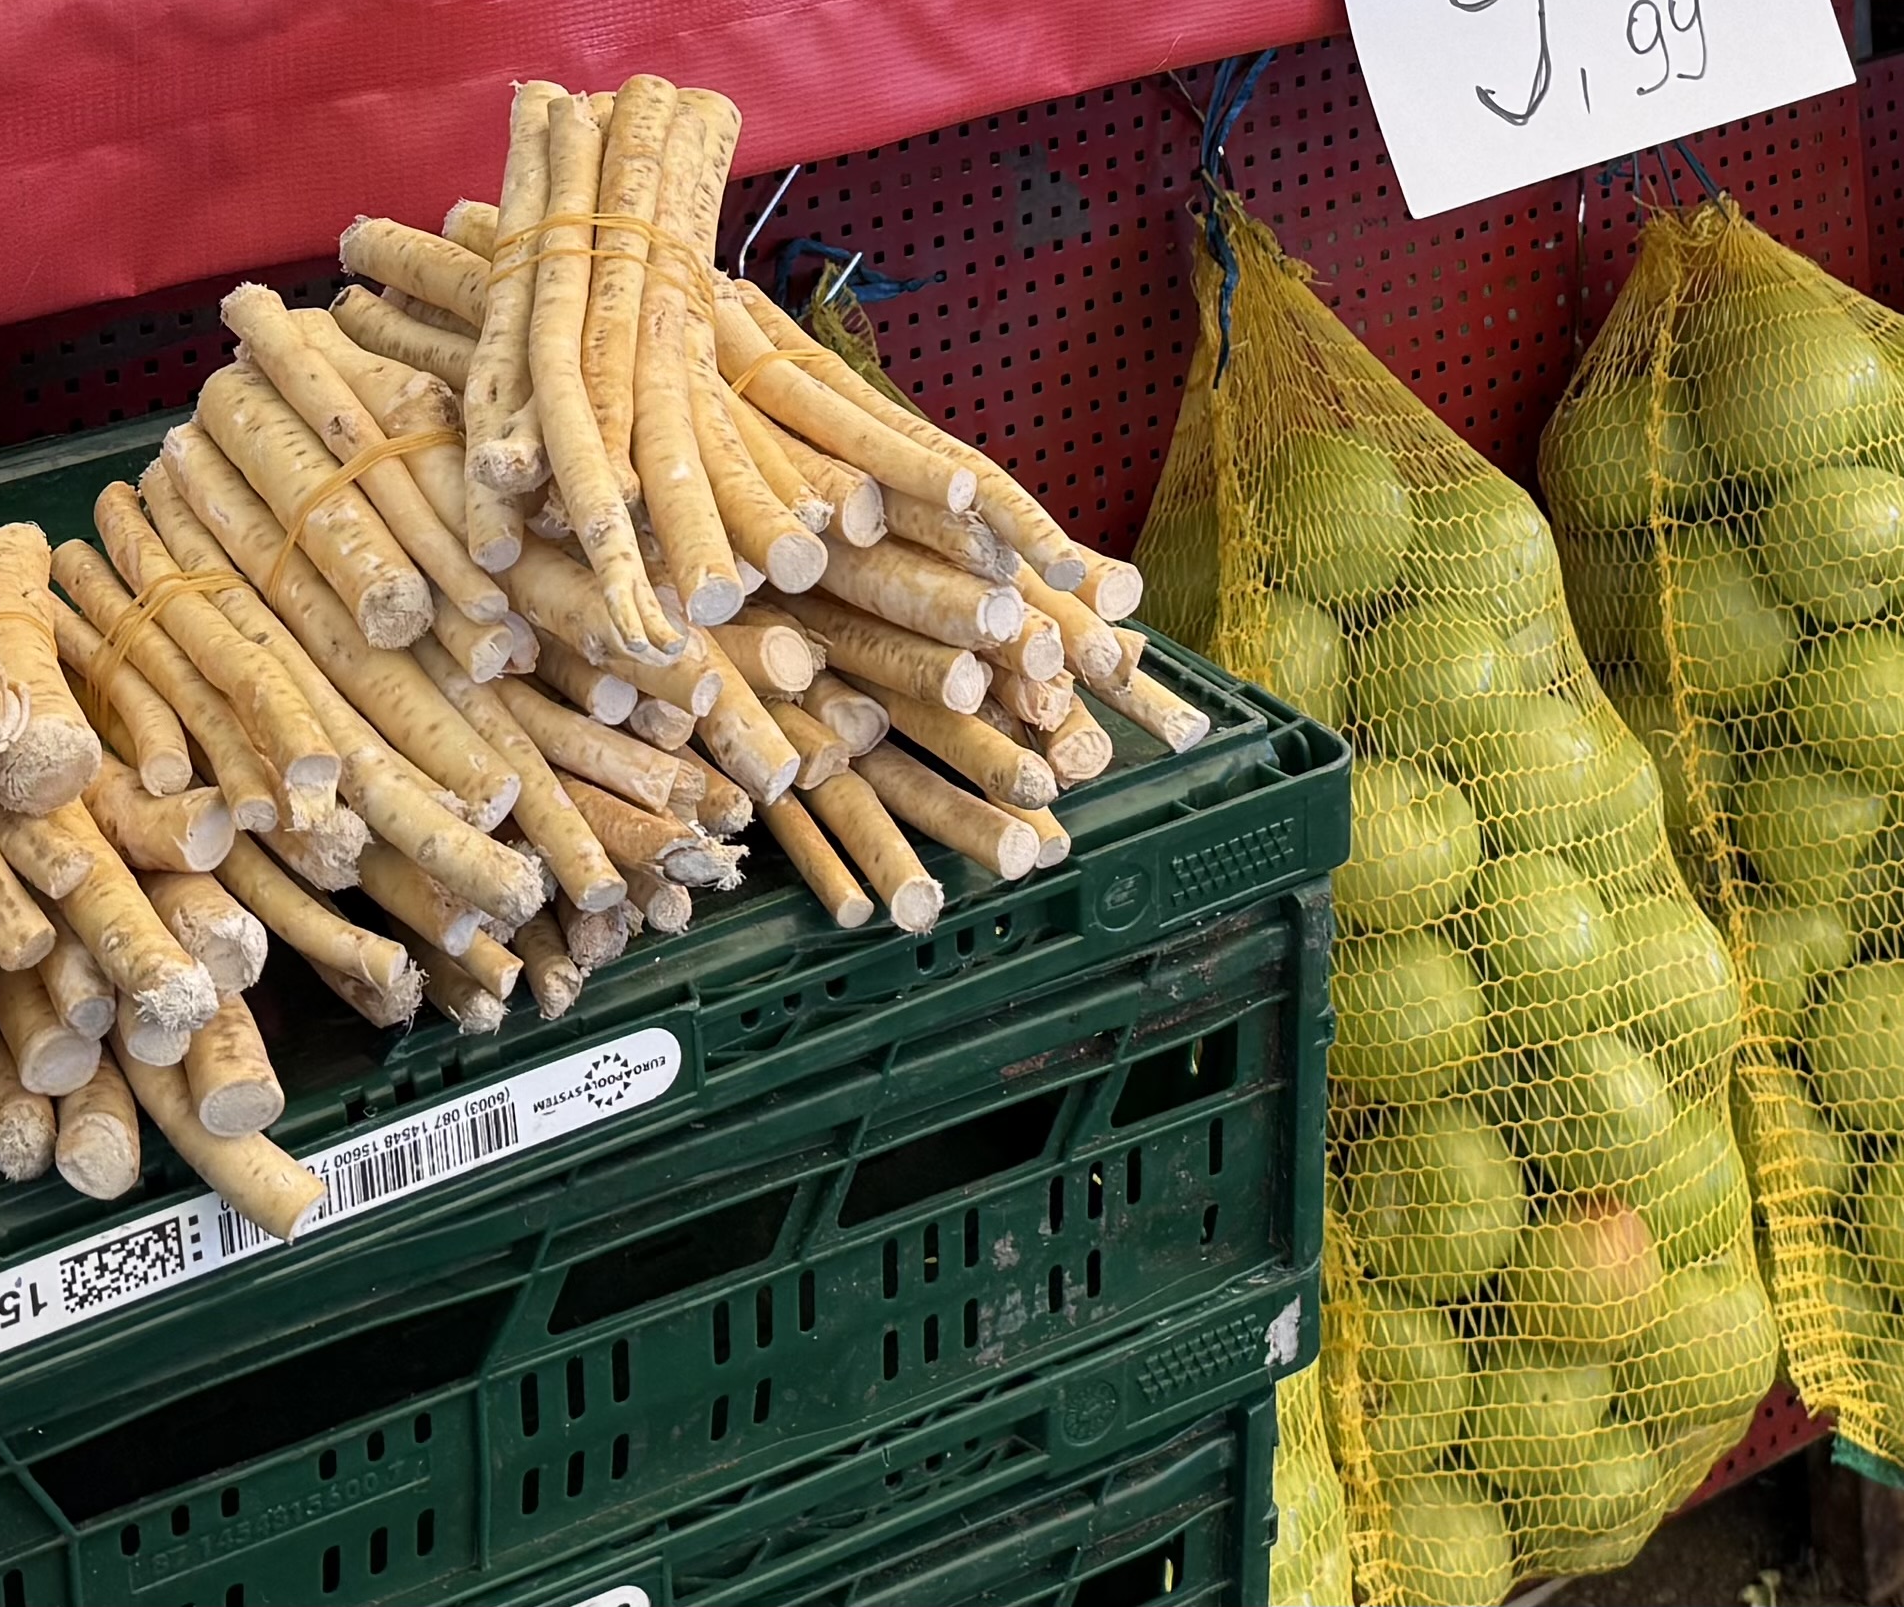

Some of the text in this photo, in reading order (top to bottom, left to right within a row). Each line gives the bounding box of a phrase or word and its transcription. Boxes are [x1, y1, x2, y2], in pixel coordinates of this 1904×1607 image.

[533, 1056, 666, 1114] EURO POOL SYSTEM
[434, 1106, 460, 1131] 087
[384, 1122, 430, 1148] 14548
[333, 1138, 380, 1166] 15600
